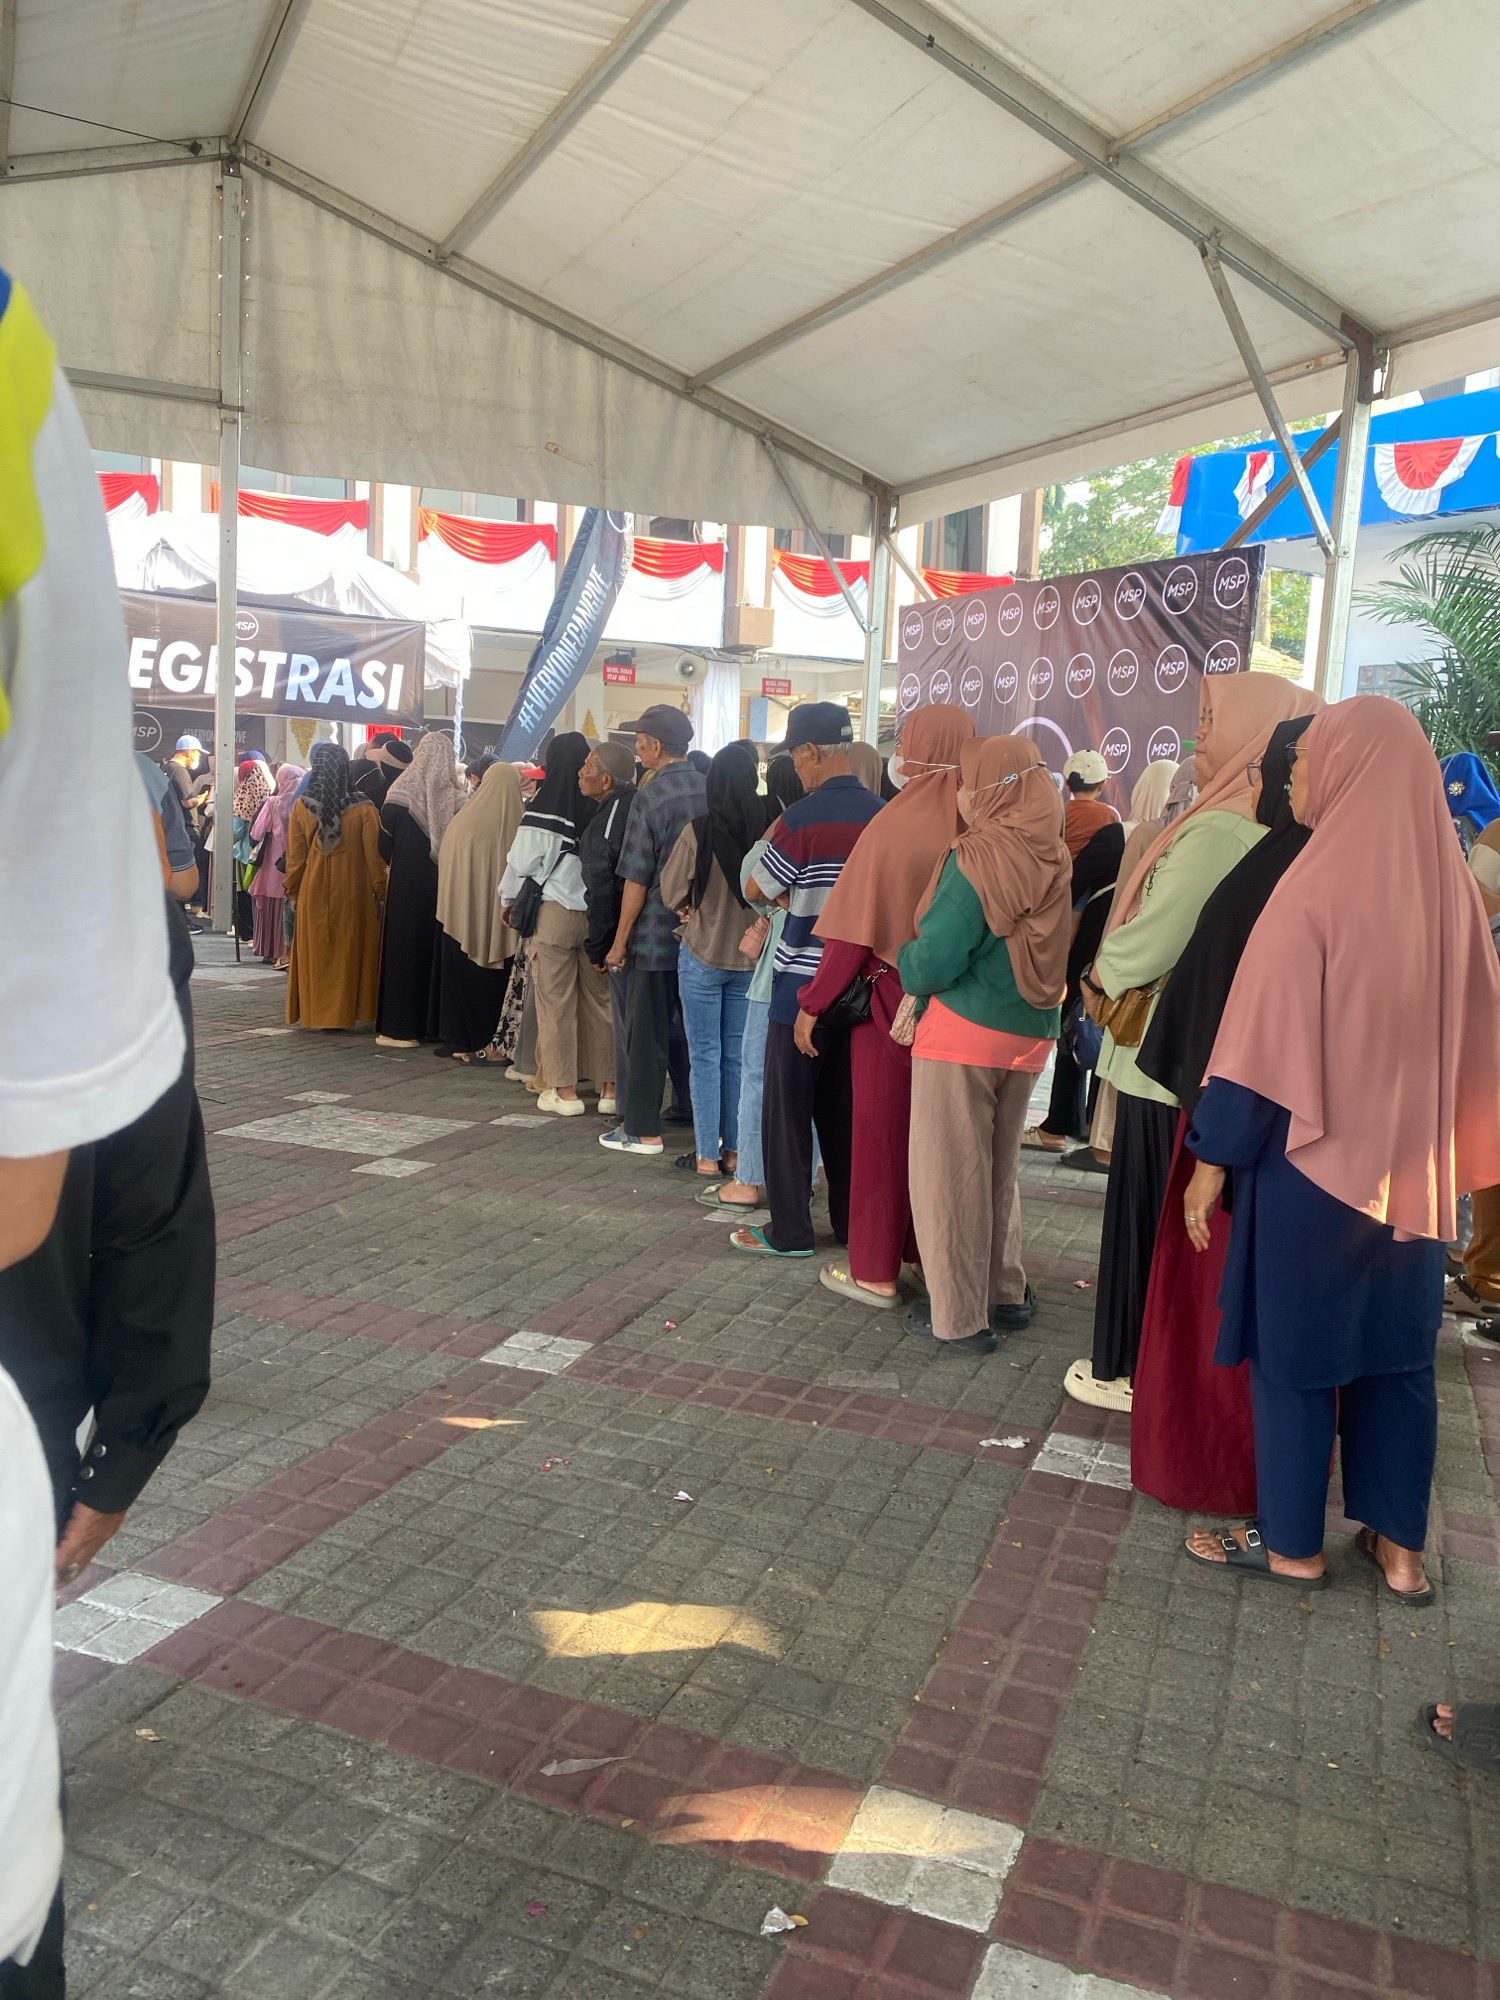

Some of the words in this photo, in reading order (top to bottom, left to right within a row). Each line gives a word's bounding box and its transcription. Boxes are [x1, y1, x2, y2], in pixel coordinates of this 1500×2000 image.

[1167, 581, 1193, 597] MSP
[1218, 574, 1246, 591] MSP
[1076, 595, 1098, 609] MSP
[1118, 588, 1142, 604] MSP
[1001, 607, 1020, 621] MSP
[1037, 601, 1057, 615] MSP
[935, 619, 952, 632] MSP
[967, 613, 984, 626] MSP
[905, 624, 921, 636] MSP
[518, 563, 612, 735] #EVERYONECANGIVE
[1159, 661, 1185, 675] MSP
[1209, 656, 1236, 672] MSP
[128, 637, 404, 710] EGISTRASI
[1031, 672, 1050, 685] MSP
[1069, 669, 1092, 682] MSP
[1111, 666, 1135, 679] MSP
[932, 682, 948, 694] MSP
[963, 679, 981, 691] MSP
[997, 676, 1015, 689] MSP
[902, 686, 918, 698] MSP
[1104, 743, 1127, 757] MSP
[1151, 742, 1176, 756] MSP
